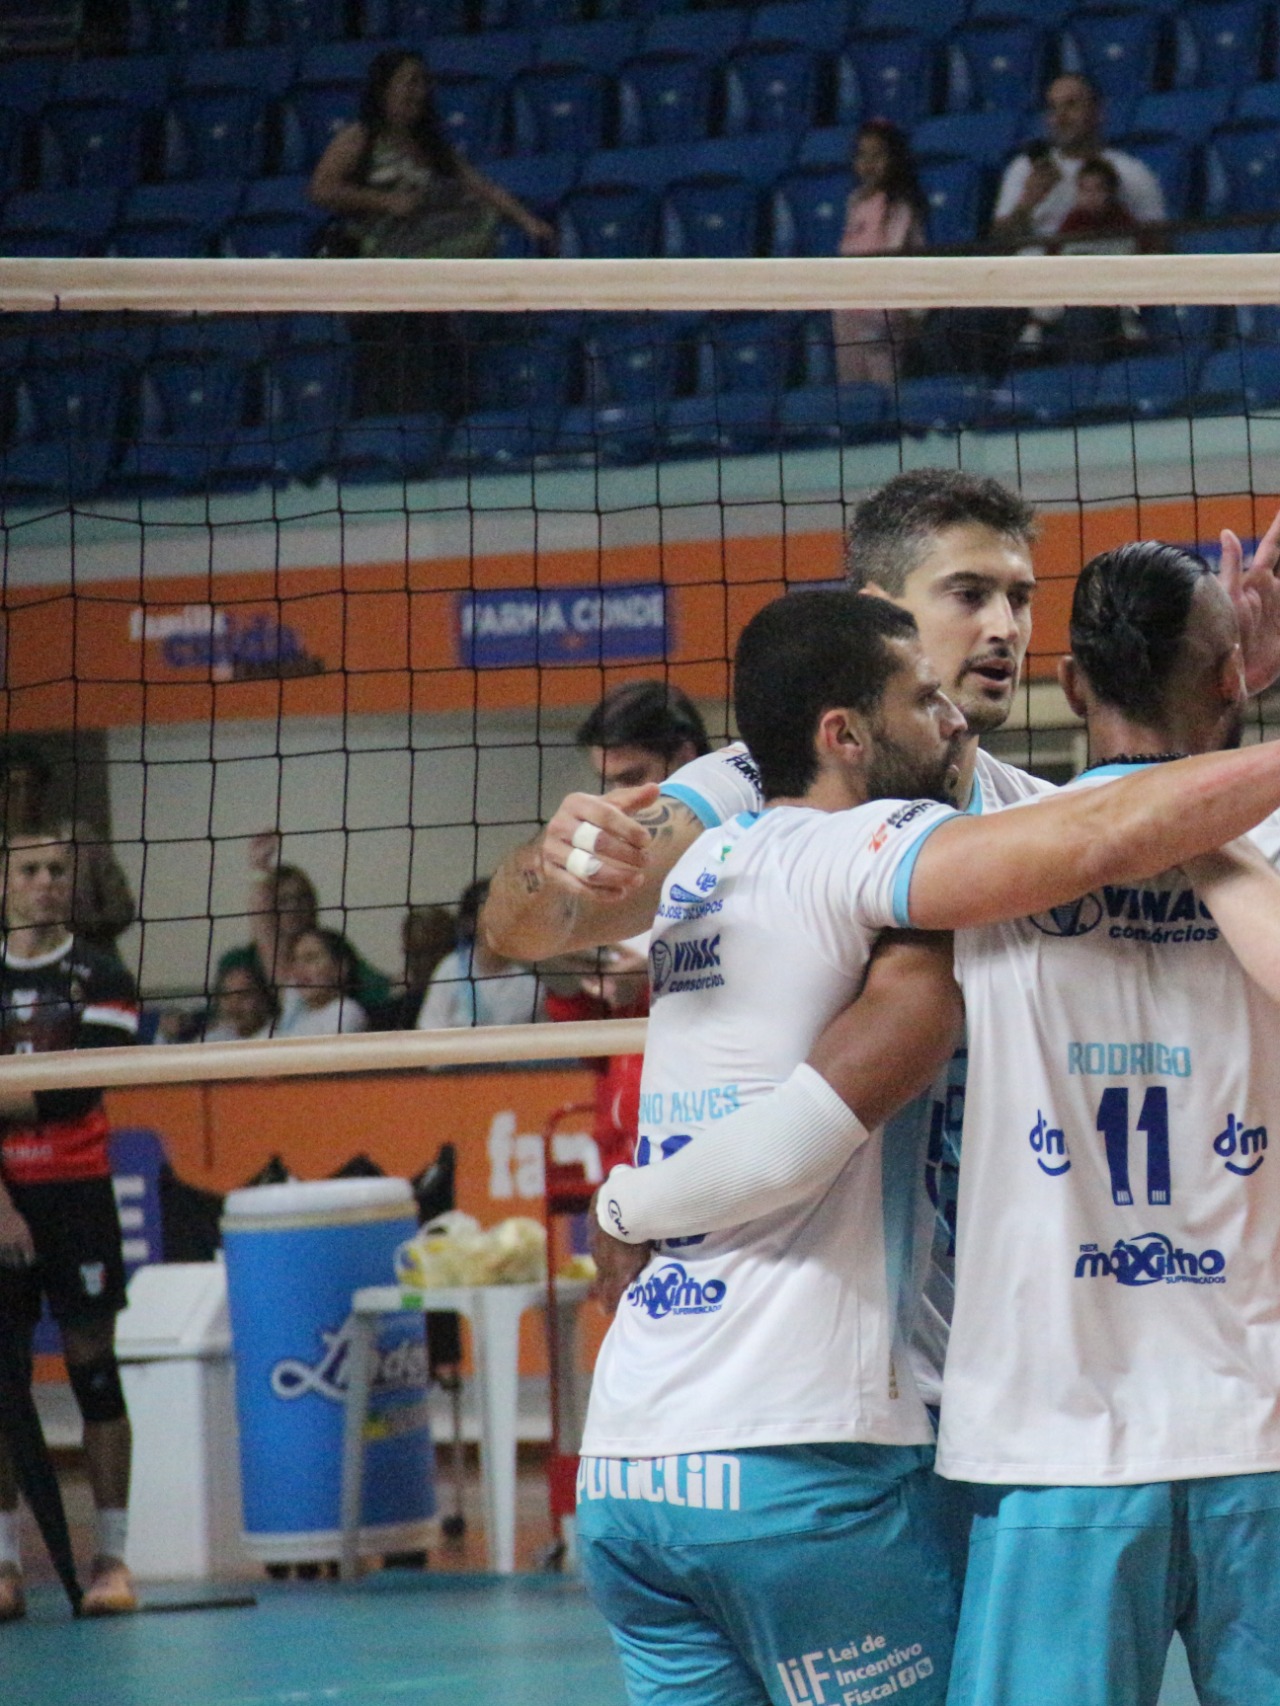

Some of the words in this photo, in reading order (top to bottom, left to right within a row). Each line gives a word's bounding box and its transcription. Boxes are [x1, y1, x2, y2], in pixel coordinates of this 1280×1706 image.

[461, 600, 568, 637] FARMA
[570, 593, 665, 632] CONDE
[1067, 1042, 1192, 1078] RODRIGO
[670, 1084, 741, 1122] ALVES
[1097, 1086, 1171, 1206] 11
[828, 1641, 859, 1663] Lei
[861, 1634, 886, 1653] de
[835, 1643, 922, 1686] Incentivo
[843, 1676, 898, 1706] Fiscal
